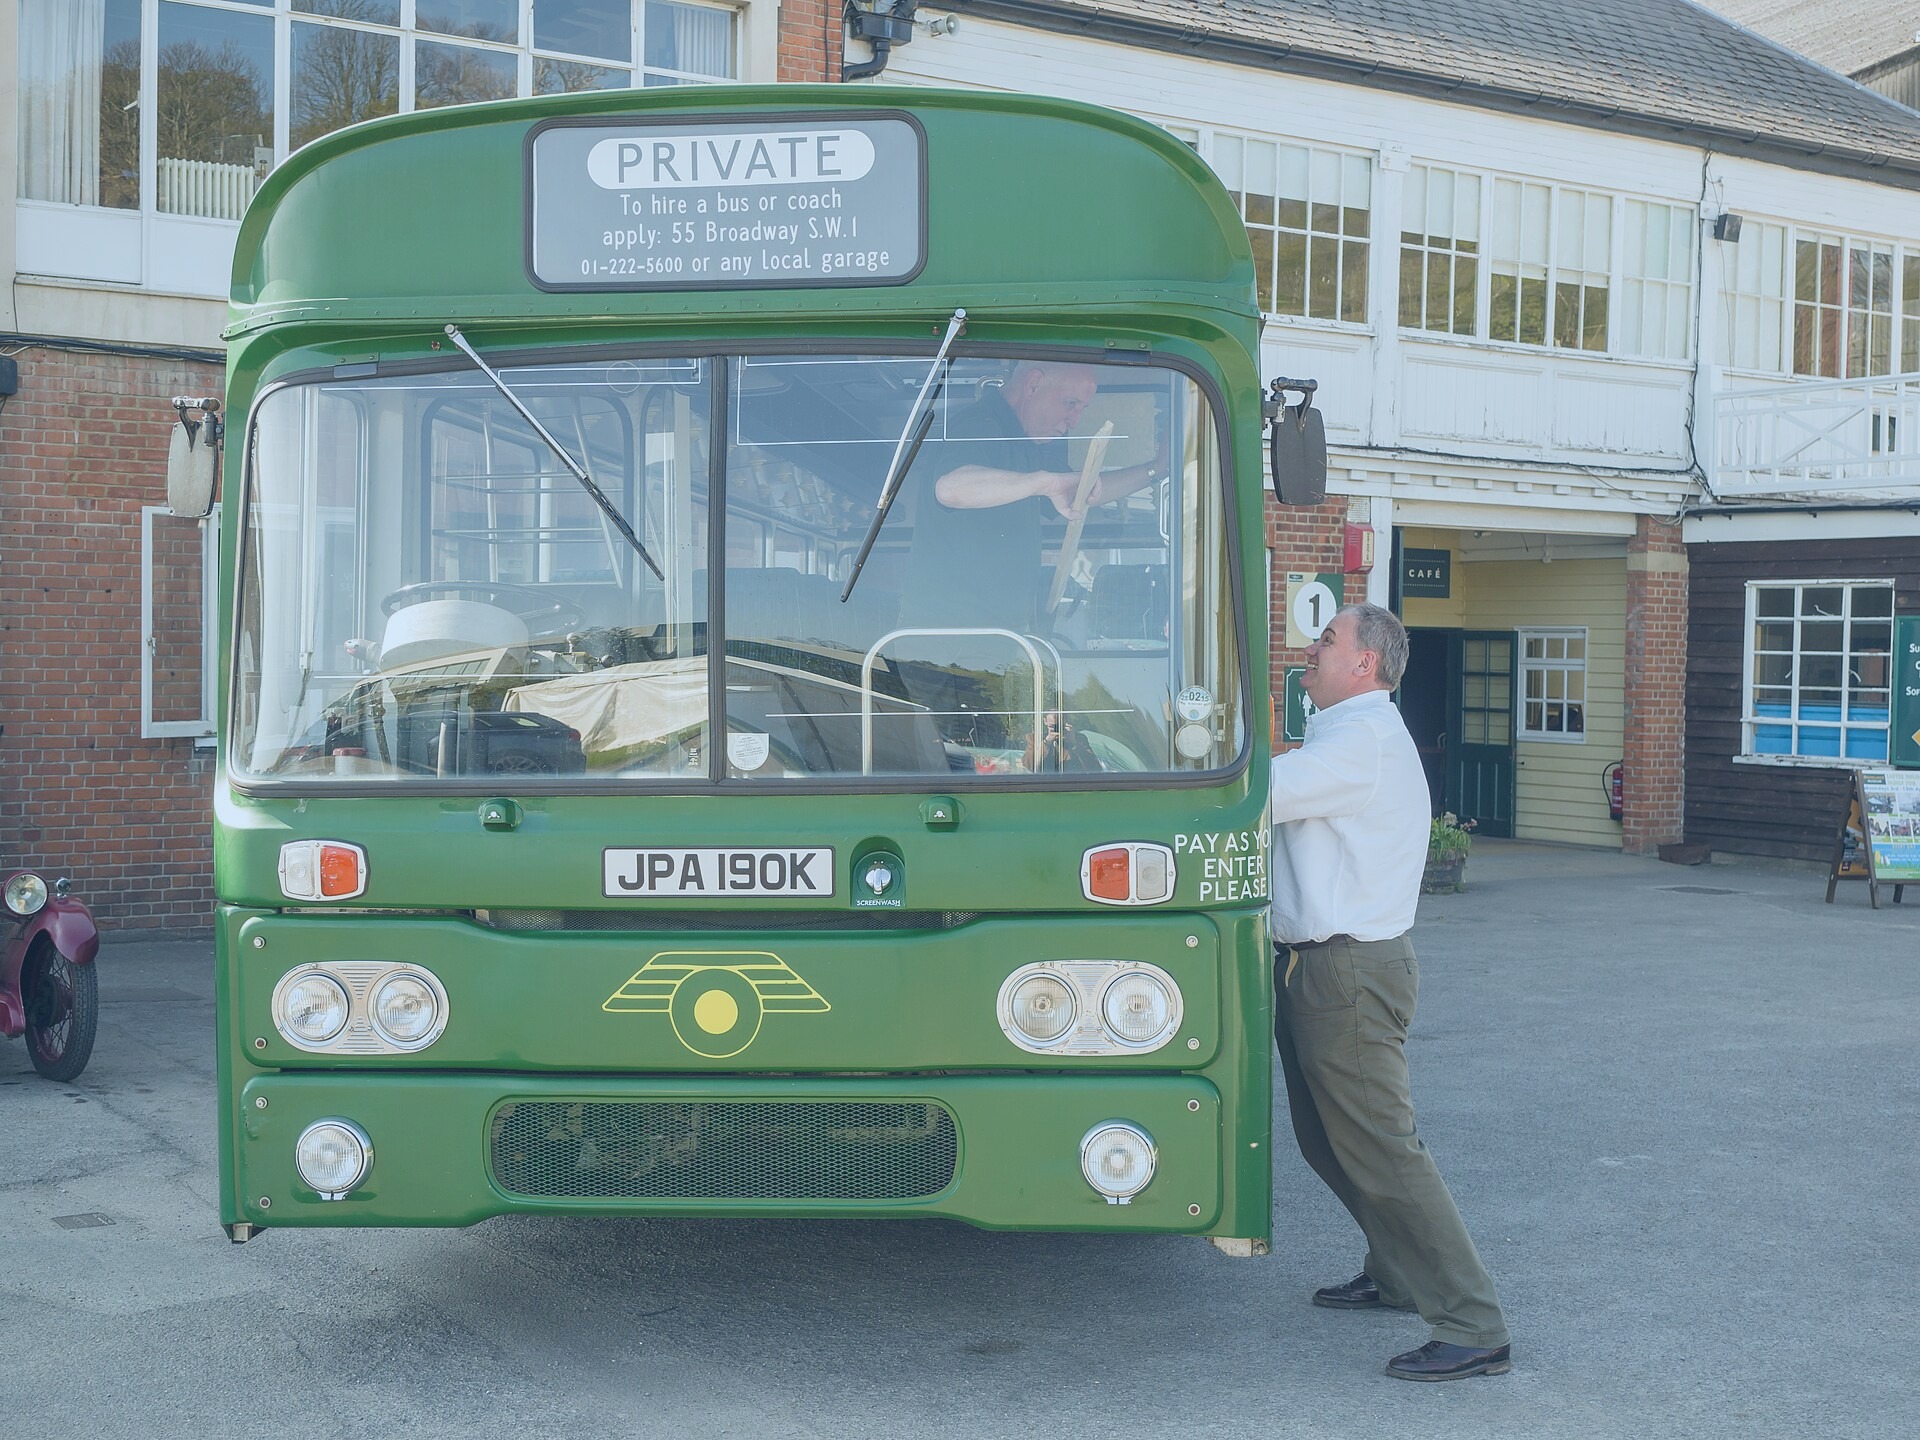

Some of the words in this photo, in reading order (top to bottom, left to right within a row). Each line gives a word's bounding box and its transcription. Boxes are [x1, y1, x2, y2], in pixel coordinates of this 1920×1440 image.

[618, 135, 842, 184] PRIVATE
[620, 194, 642, 216] To
[651, 193, 687, 215] hire
[697, 198, 707, 214] a
[717, 191, 749, 213] bus
[759, 195, 778, 211] or
[787, 187, 842, 210] coach
[603, 223, 661, 250] apply:
[672, 221, 695, 244] 55
[706, 220, 798, 245] Broadway
[581, 256, 683, 275] 01-222-5600
[692, 256, 711, 272] or
[720, 255, 752, 276] any
[762, 248, 812, 270] local
[821, 250, 890, 273] garage
[1408, 567, 1441, 579] CAFÉ
[1309, 593, 1320, 628] 1
[1174, 833, 1220, 854] PAY
[1225, 831, 1249, 853] AS
[1253, 828, 1271, 850] YO
[617, 853, 705, 890] JPA
[718, 852, 817, 890] 190K
[1204, 855, 1265, 878] ENTER
[856, 899, 901, 907] SCREENWASH
[1199, 877, 1267, 901] PLEASE
